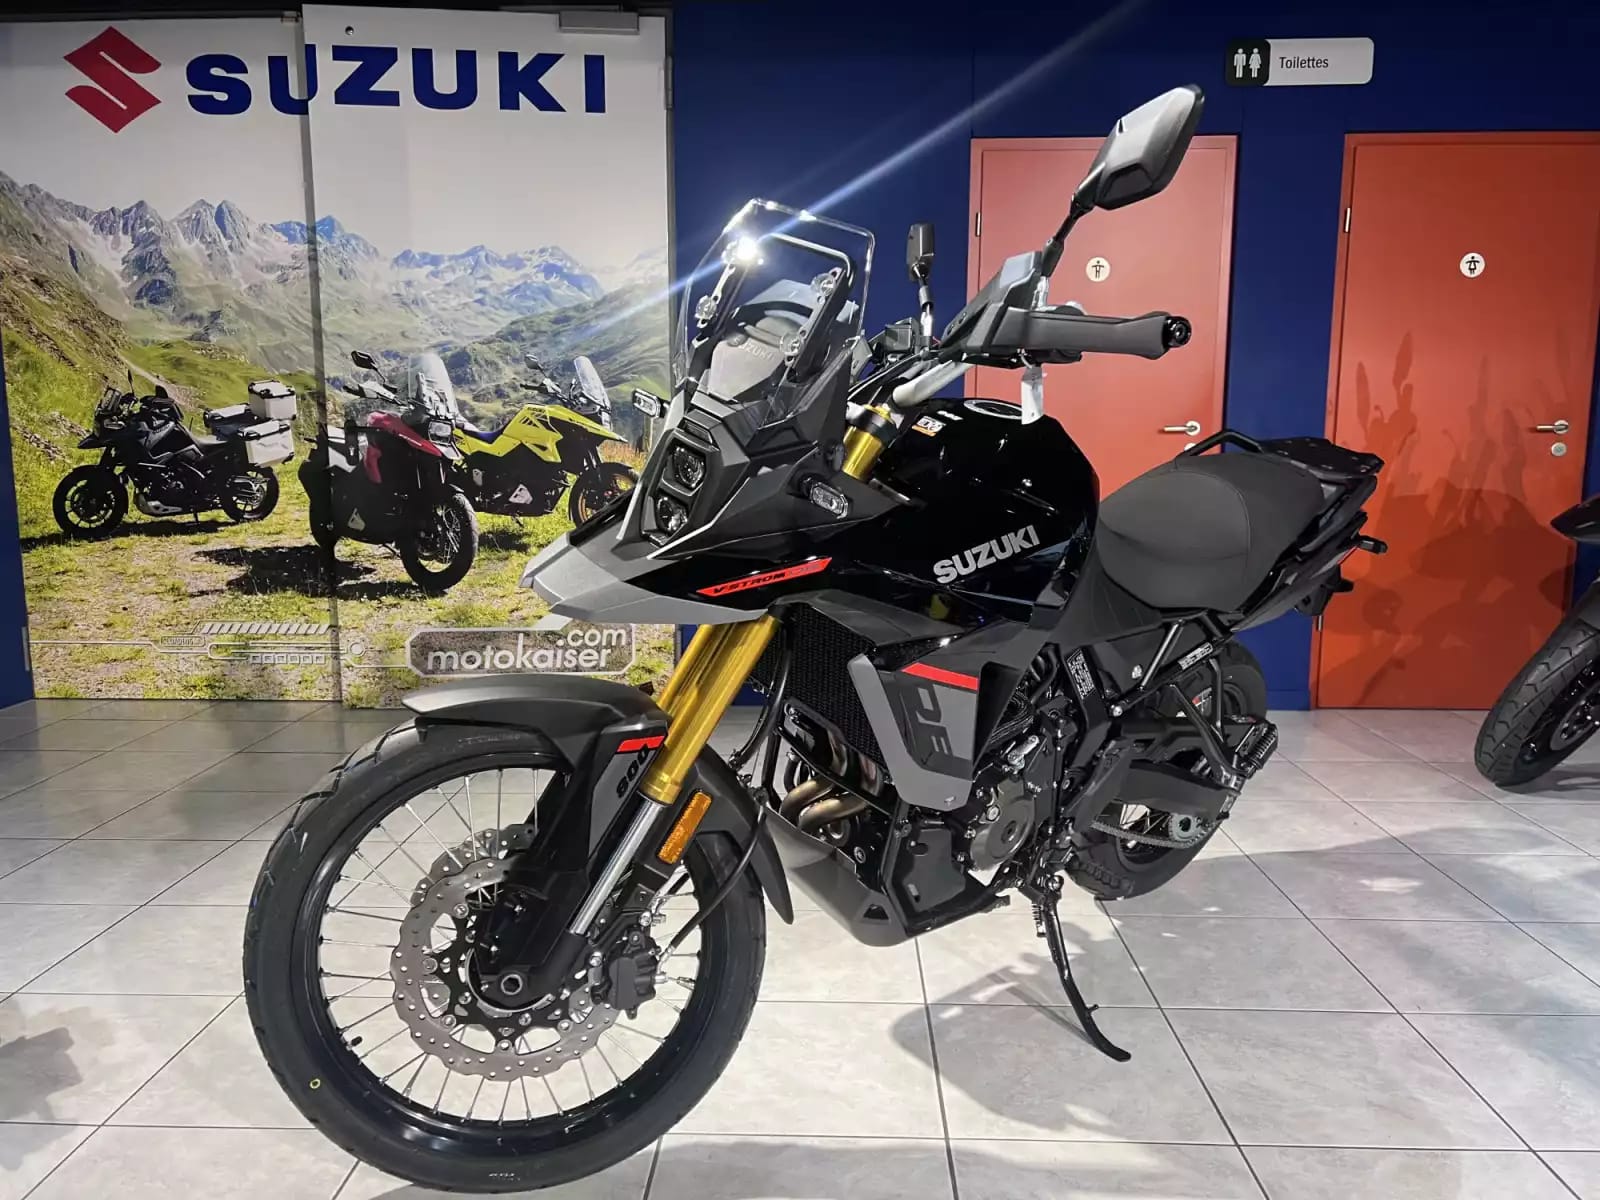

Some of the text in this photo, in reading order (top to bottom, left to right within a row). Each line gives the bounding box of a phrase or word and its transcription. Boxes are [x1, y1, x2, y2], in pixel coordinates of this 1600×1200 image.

[185, 44, 607, 116] SUZUKI
[1279, 56, 1329, 69] Toilettes
[933, 525, 1040, 584] SUZUKI
[427, 633, 612, 671] motokaiser
[557, 628, 626, 647] .com
[616, 743, 649, 799] 800
